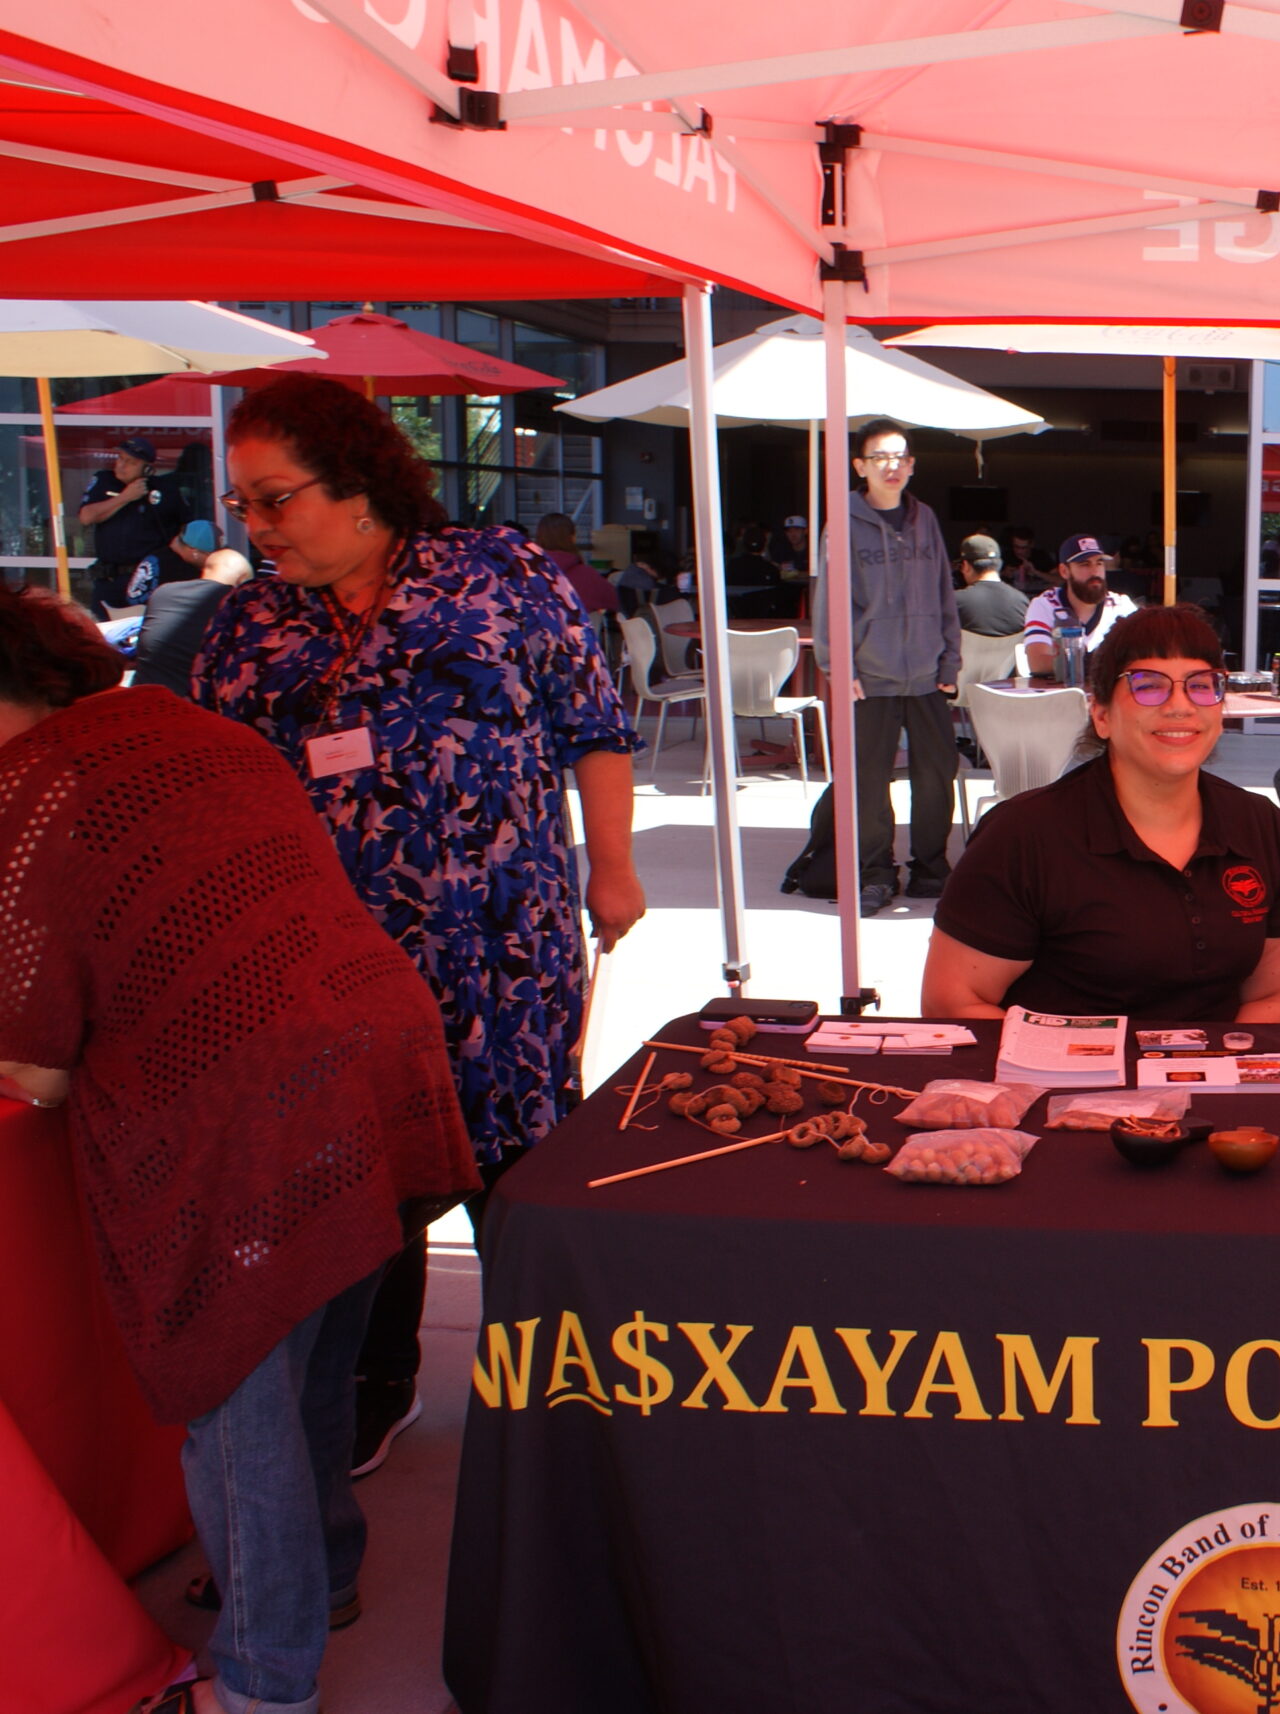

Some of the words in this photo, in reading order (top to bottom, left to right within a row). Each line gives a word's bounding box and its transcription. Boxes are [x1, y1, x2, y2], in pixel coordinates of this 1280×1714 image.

[857, 546, 933, 568] Reebk
[472, 1310, 1101, 1425] WA$XAYAM
[1129, 1584, 1169, 1675] Rincon
[1159, 1523, 1232, 1580] Band
[1240, 1514, 1270, 1539] of
[1240, 1577, 1268, 1592] Est.
